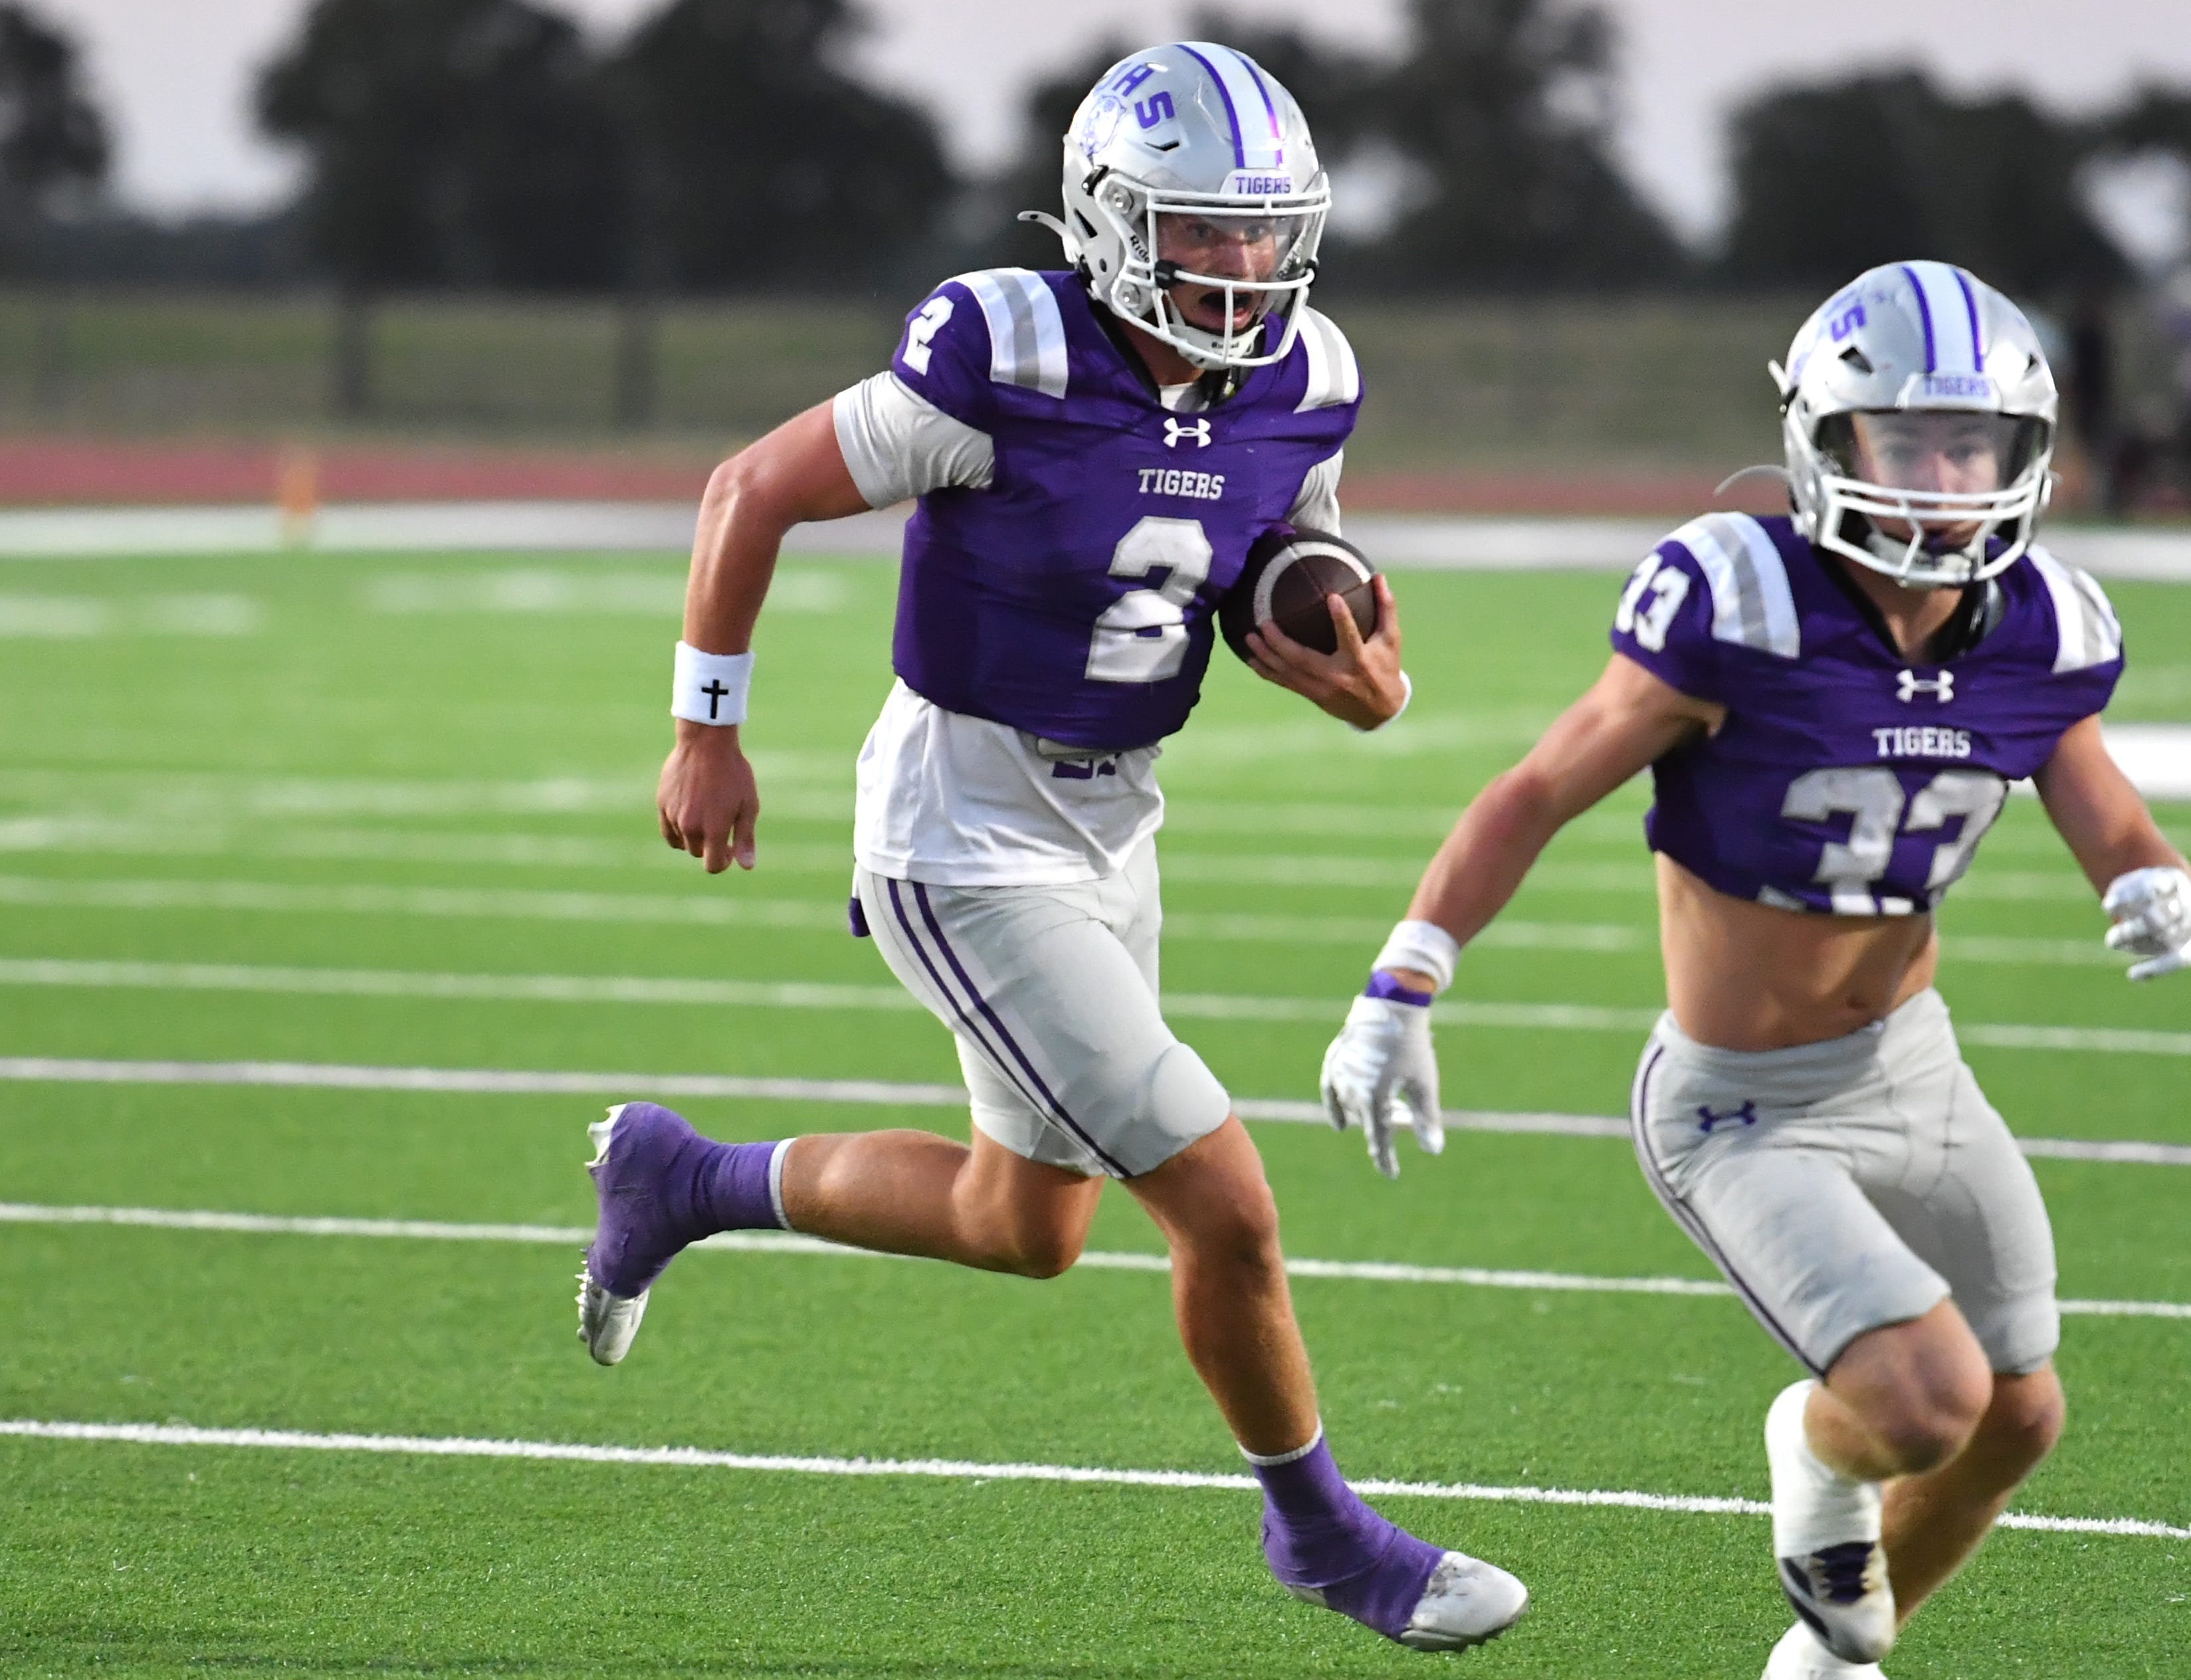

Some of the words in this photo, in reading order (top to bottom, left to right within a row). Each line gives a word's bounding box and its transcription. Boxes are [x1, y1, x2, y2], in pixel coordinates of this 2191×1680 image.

[1235, 176, 1291, 194] TIGERS
[902, 295, 954, 376] 2
[1138, 468, 1225, 500] TIGERS
[1084, 516, 1213, 683] 2
[1871, 726, 1972, 758] TIGERS
